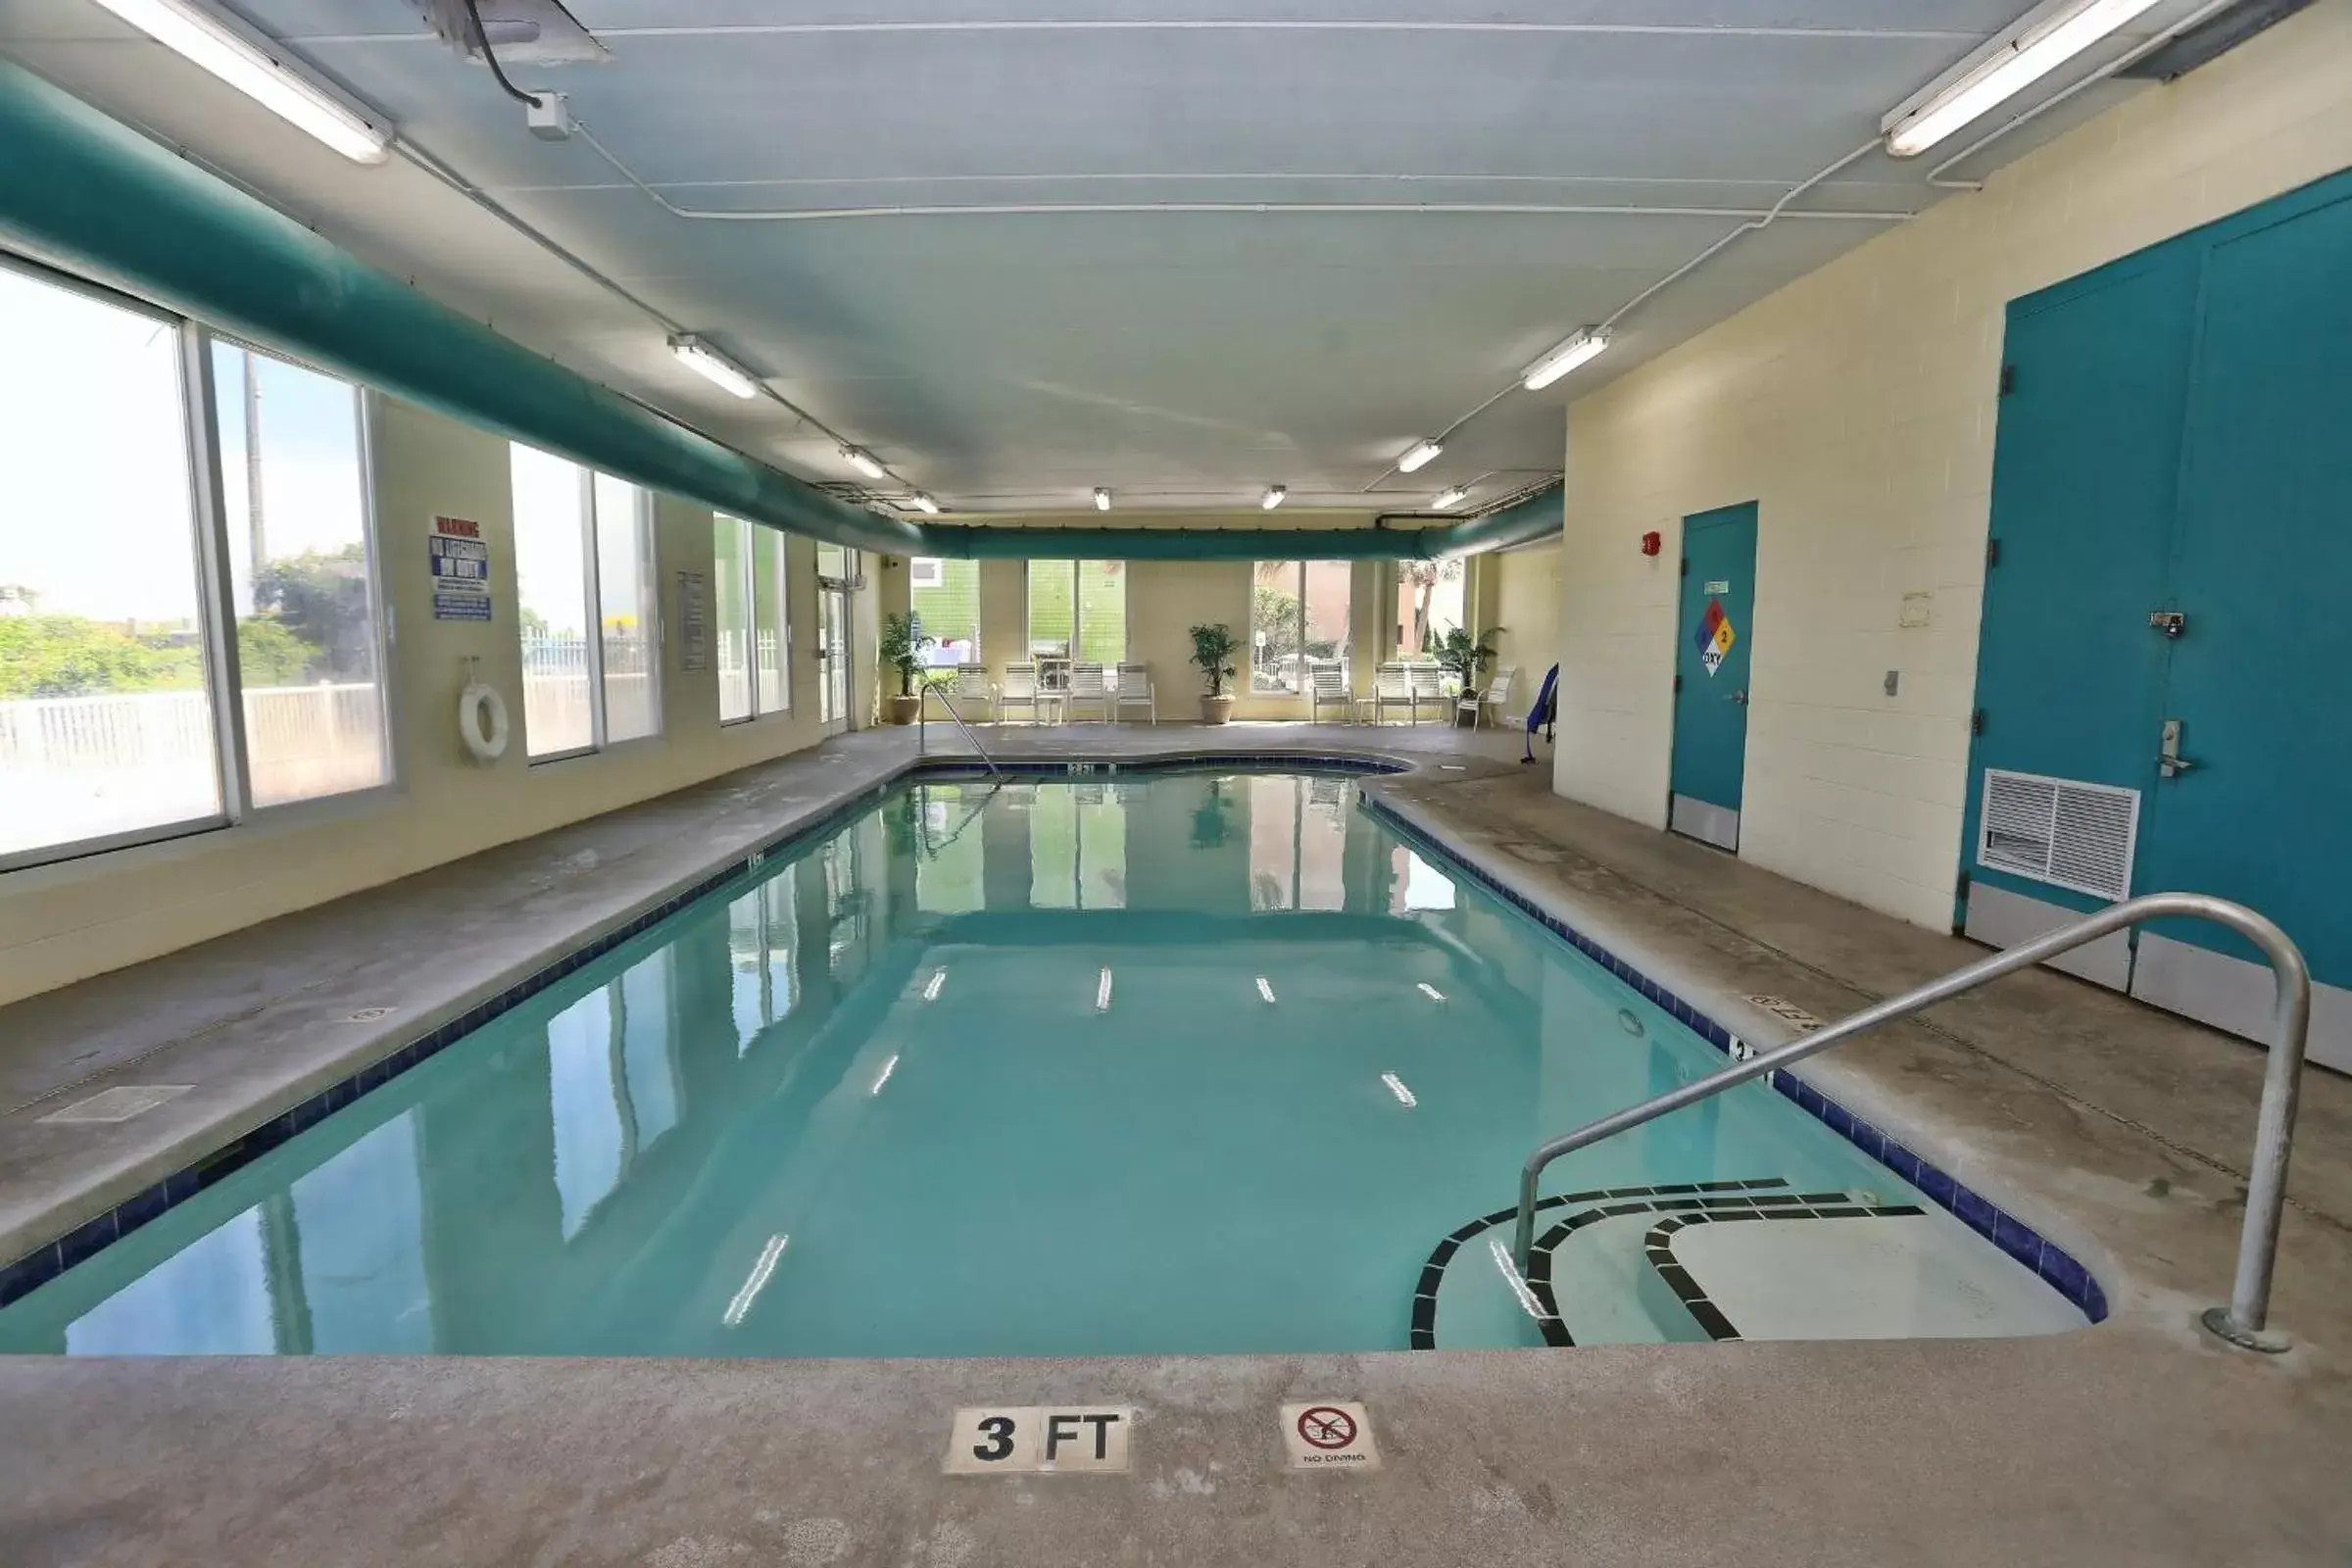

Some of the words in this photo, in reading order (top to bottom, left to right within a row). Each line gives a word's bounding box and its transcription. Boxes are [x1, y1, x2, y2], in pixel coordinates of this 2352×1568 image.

[436, 515, 479, 538] WARNING
[973, 1417, 1015, 1461] 3
[1046, 1414, 1119, 1460] FT
[1325, 1453, 1366, 1462] DIVING
